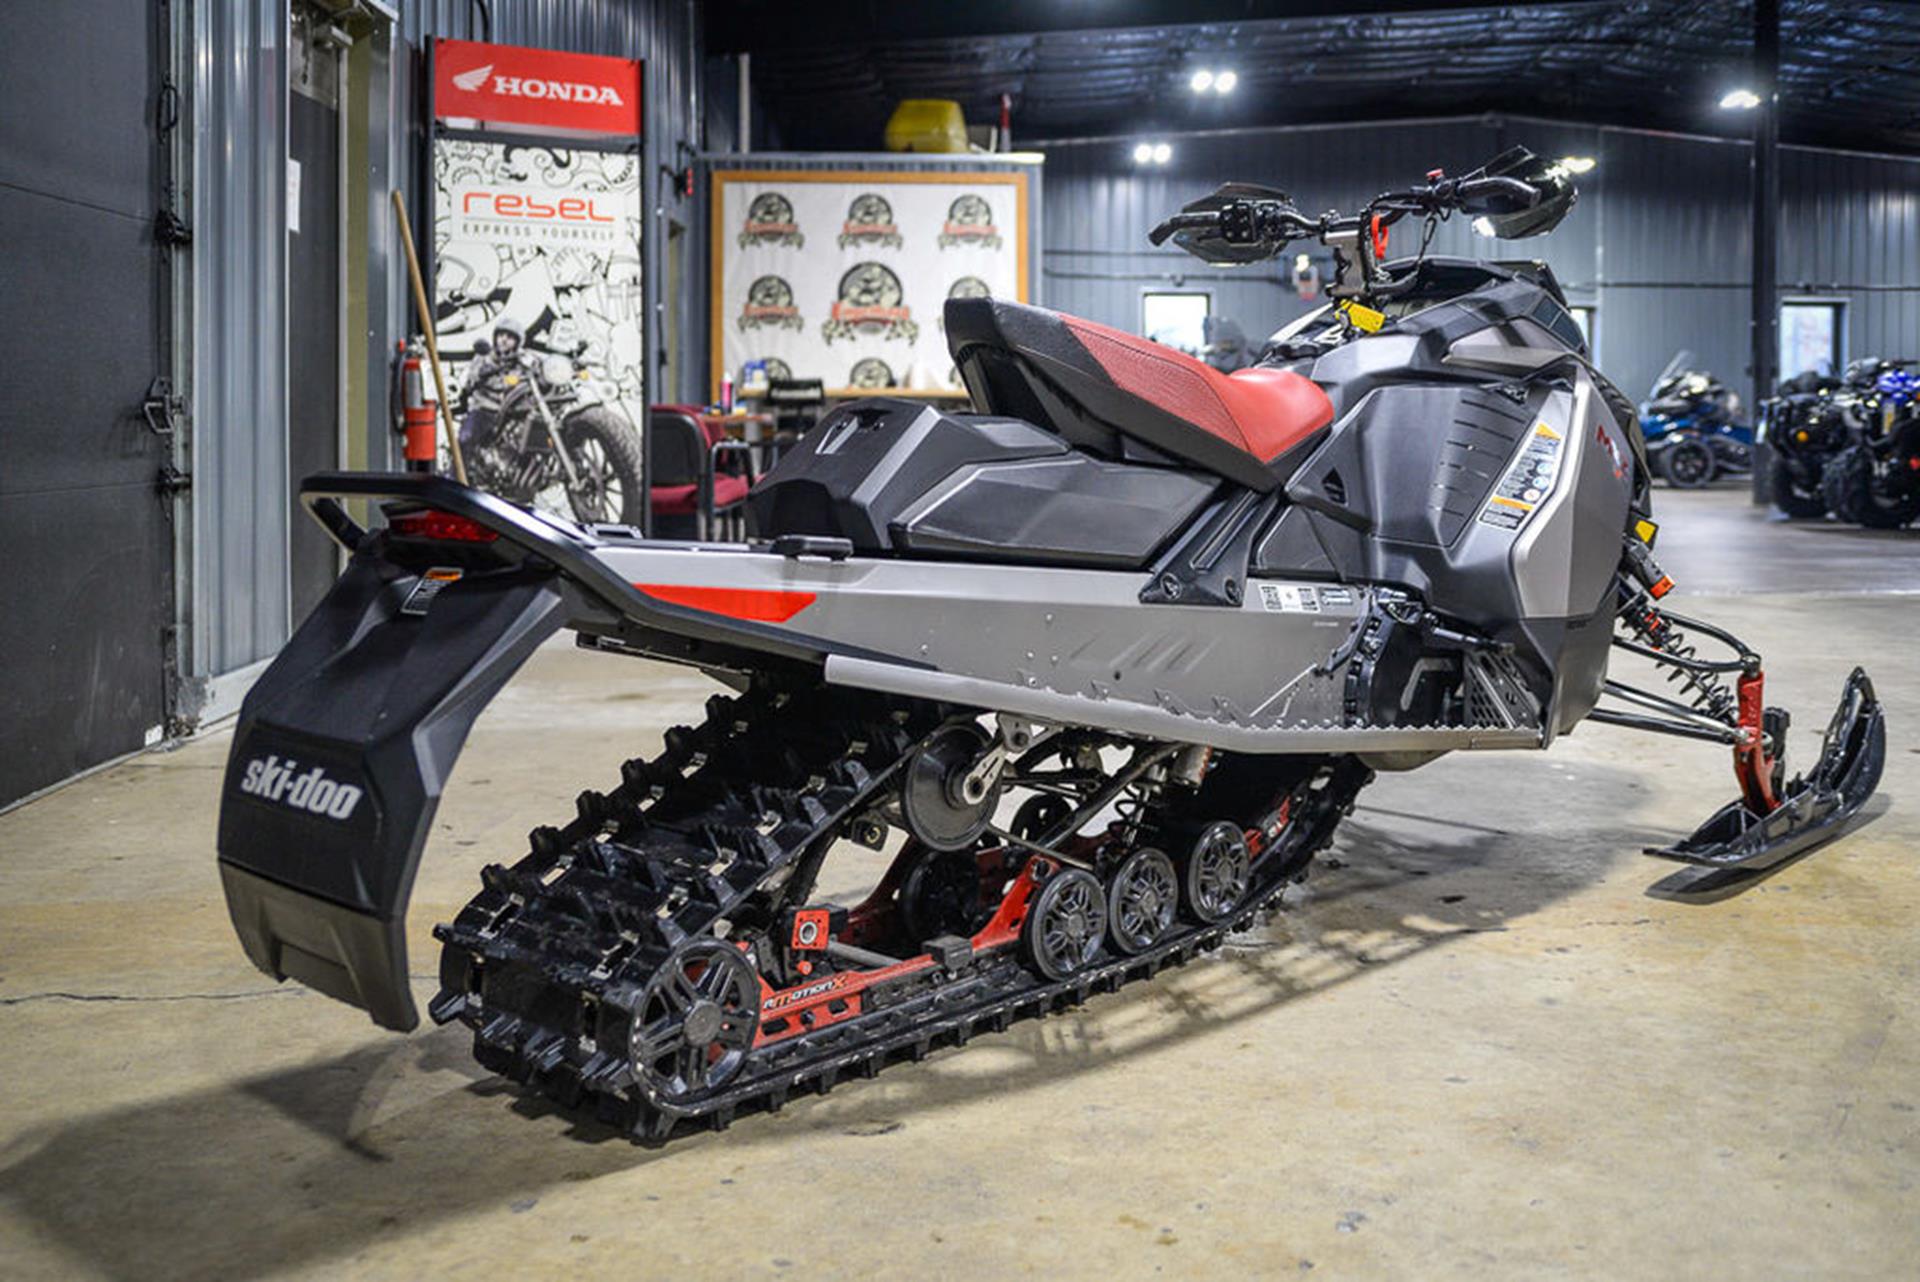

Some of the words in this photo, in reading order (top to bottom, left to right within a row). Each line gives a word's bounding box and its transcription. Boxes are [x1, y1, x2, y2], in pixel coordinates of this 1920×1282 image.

[493, 76, 624, 106] HONDA
[463, 192, 615, 222] rebel
[463, 223, 531, 236] EXPRESS
[542, 227, 614, 239] YOURSELF
[241, 755, 362, 819] ski-doo
